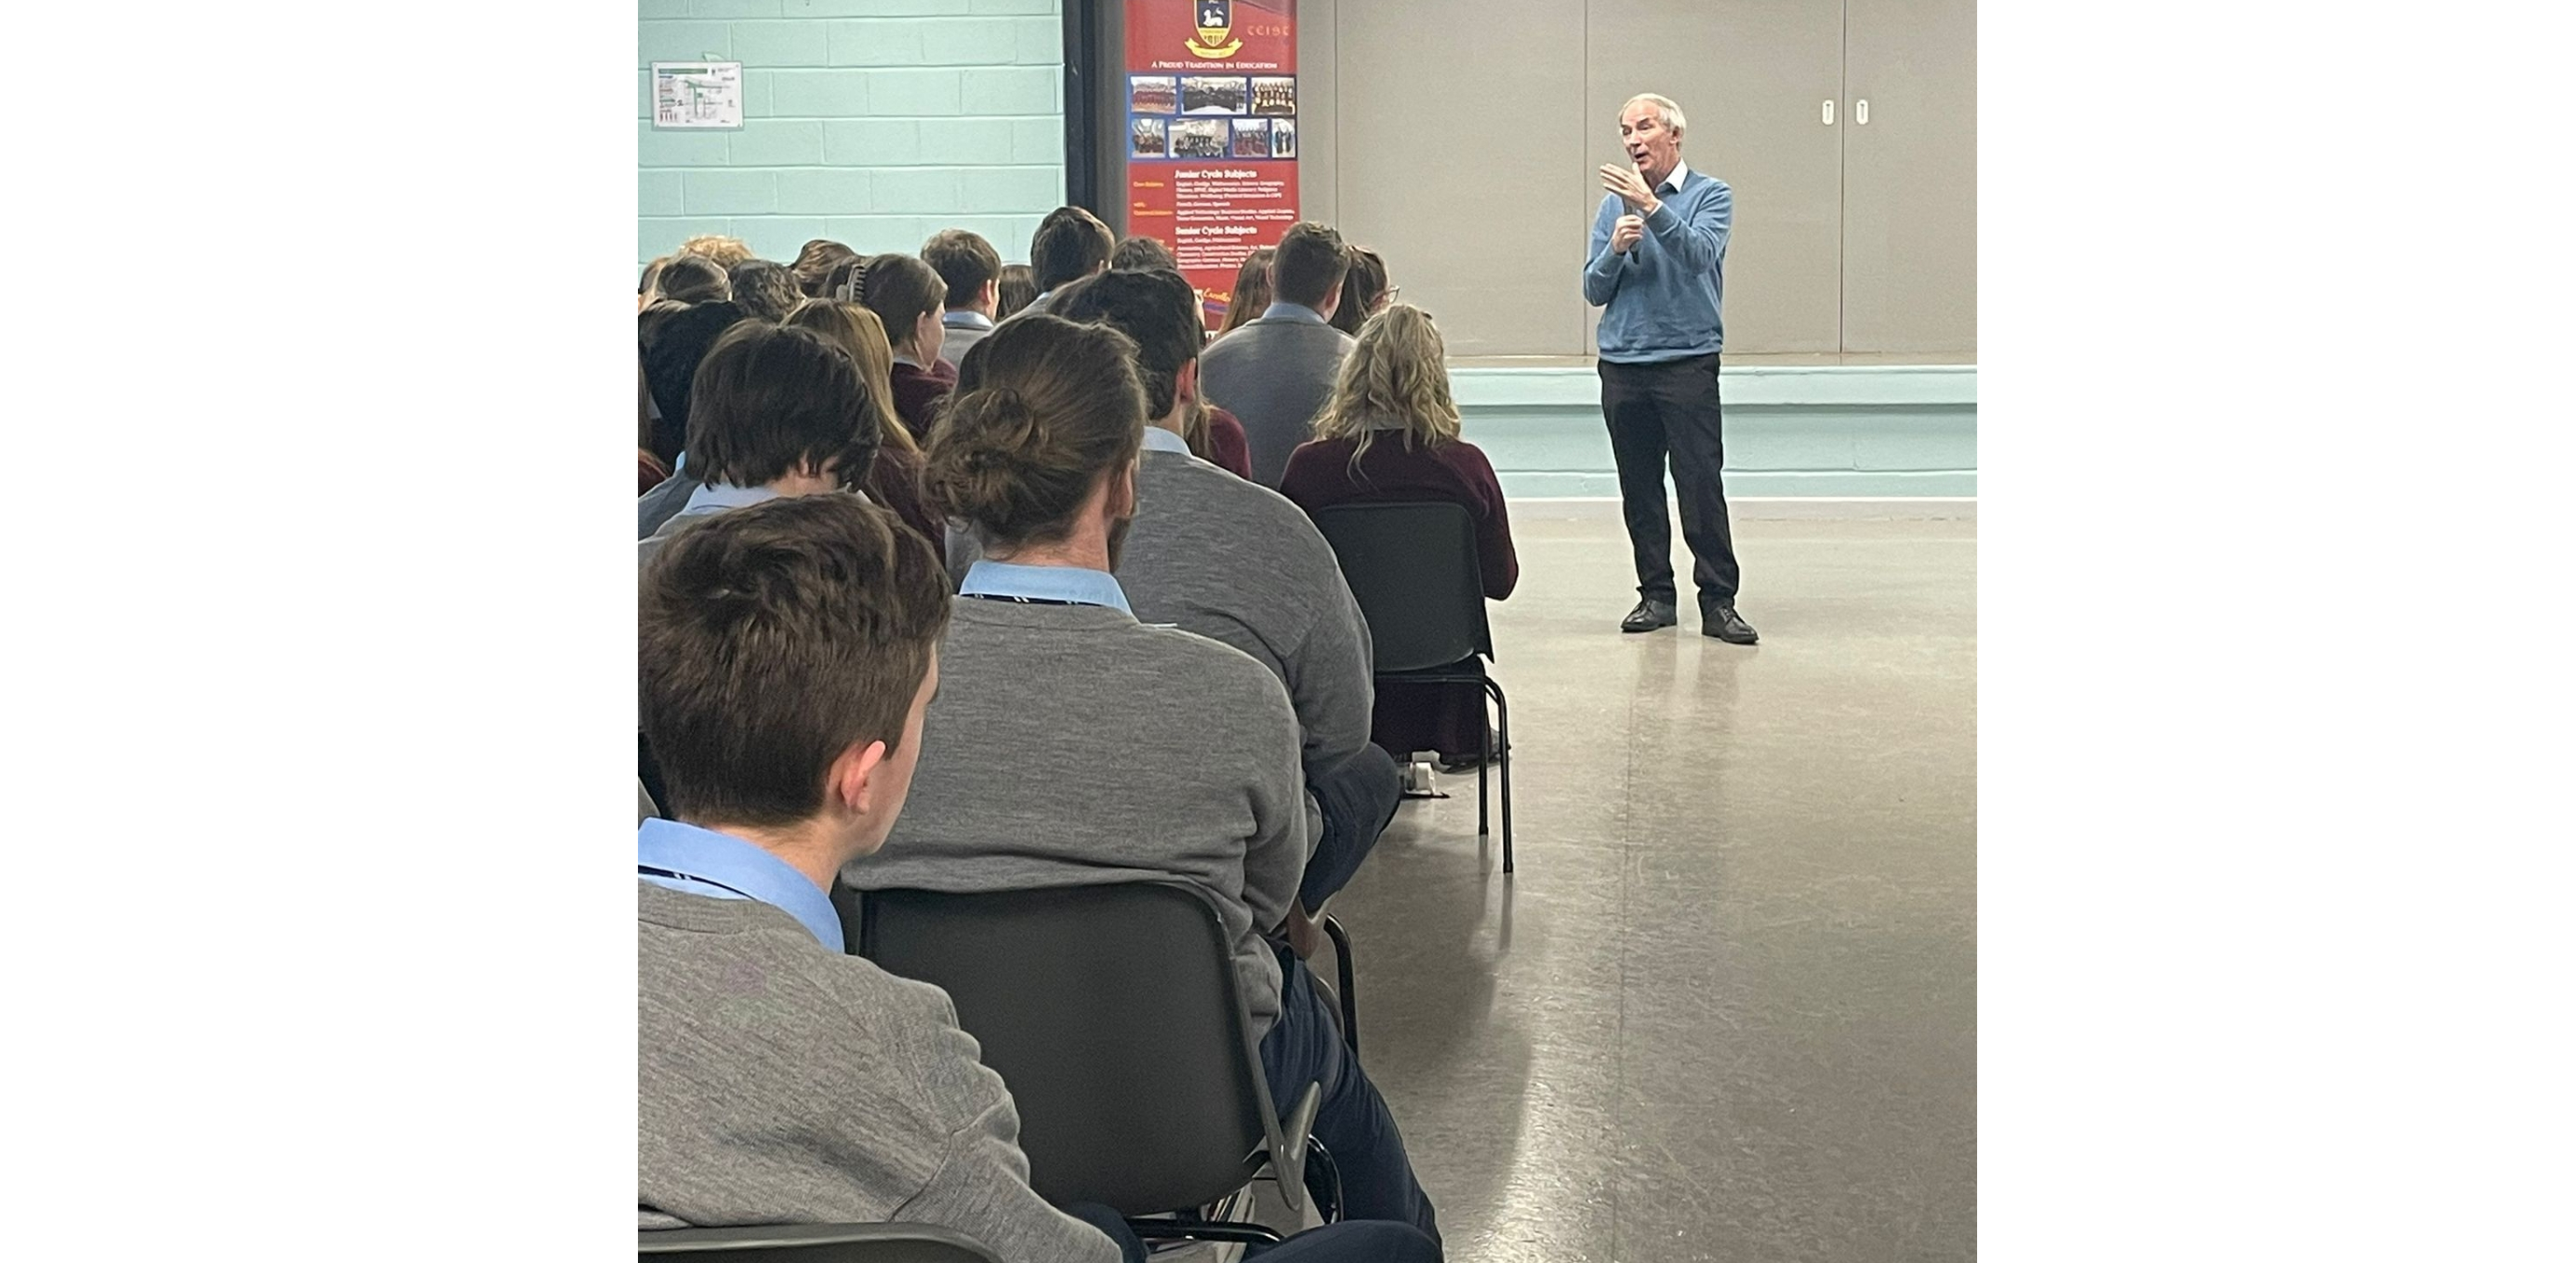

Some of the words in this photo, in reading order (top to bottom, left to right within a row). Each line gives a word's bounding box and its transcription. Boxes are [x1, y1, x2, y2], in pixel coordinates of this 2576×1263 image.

[1224, 169, 1257, 179] Subjects
[1175, 226, 1201, 235] Senior
[1201, 226, 1224, 236] Cycle
[1224, 225, 1257, 236] Subjects
